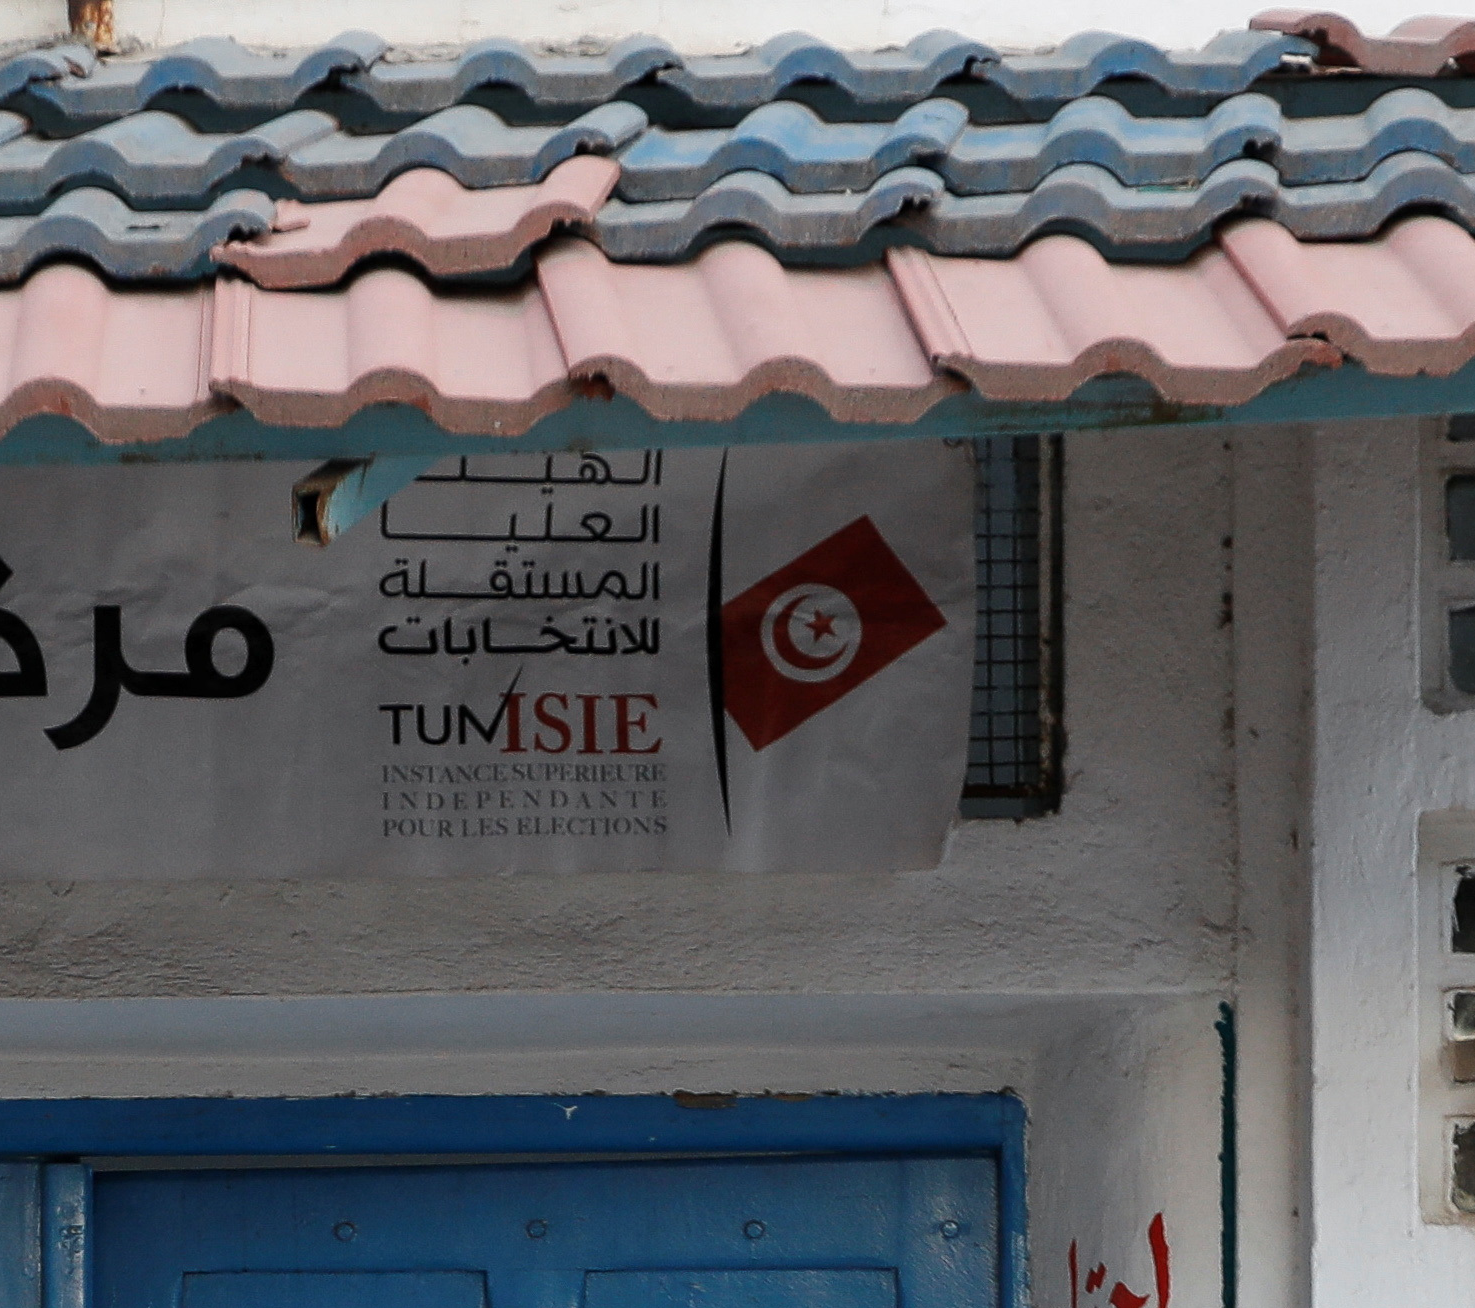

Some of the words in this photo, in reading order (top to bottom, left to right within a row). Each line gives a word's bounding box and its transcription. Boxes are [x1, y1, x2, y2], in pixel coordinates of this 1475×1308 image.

[380, 500, 659, 553] العليا
[379, 558, 660, 600] المستقلة
[378, 615, 660, 665] للانتخابات
[378, 664, 662, 755] TUNISIE
[382, 764, 507, 783] INSTANCE
[511, 762, 667, 783] SUPERIEURE
[381, 789, 667, 811] INDEPENDANTE
[382, 817, 454, 838] POUR
[461, 817, 509, 837] LES
[517, 815, 667, 837] ELECTIONS
